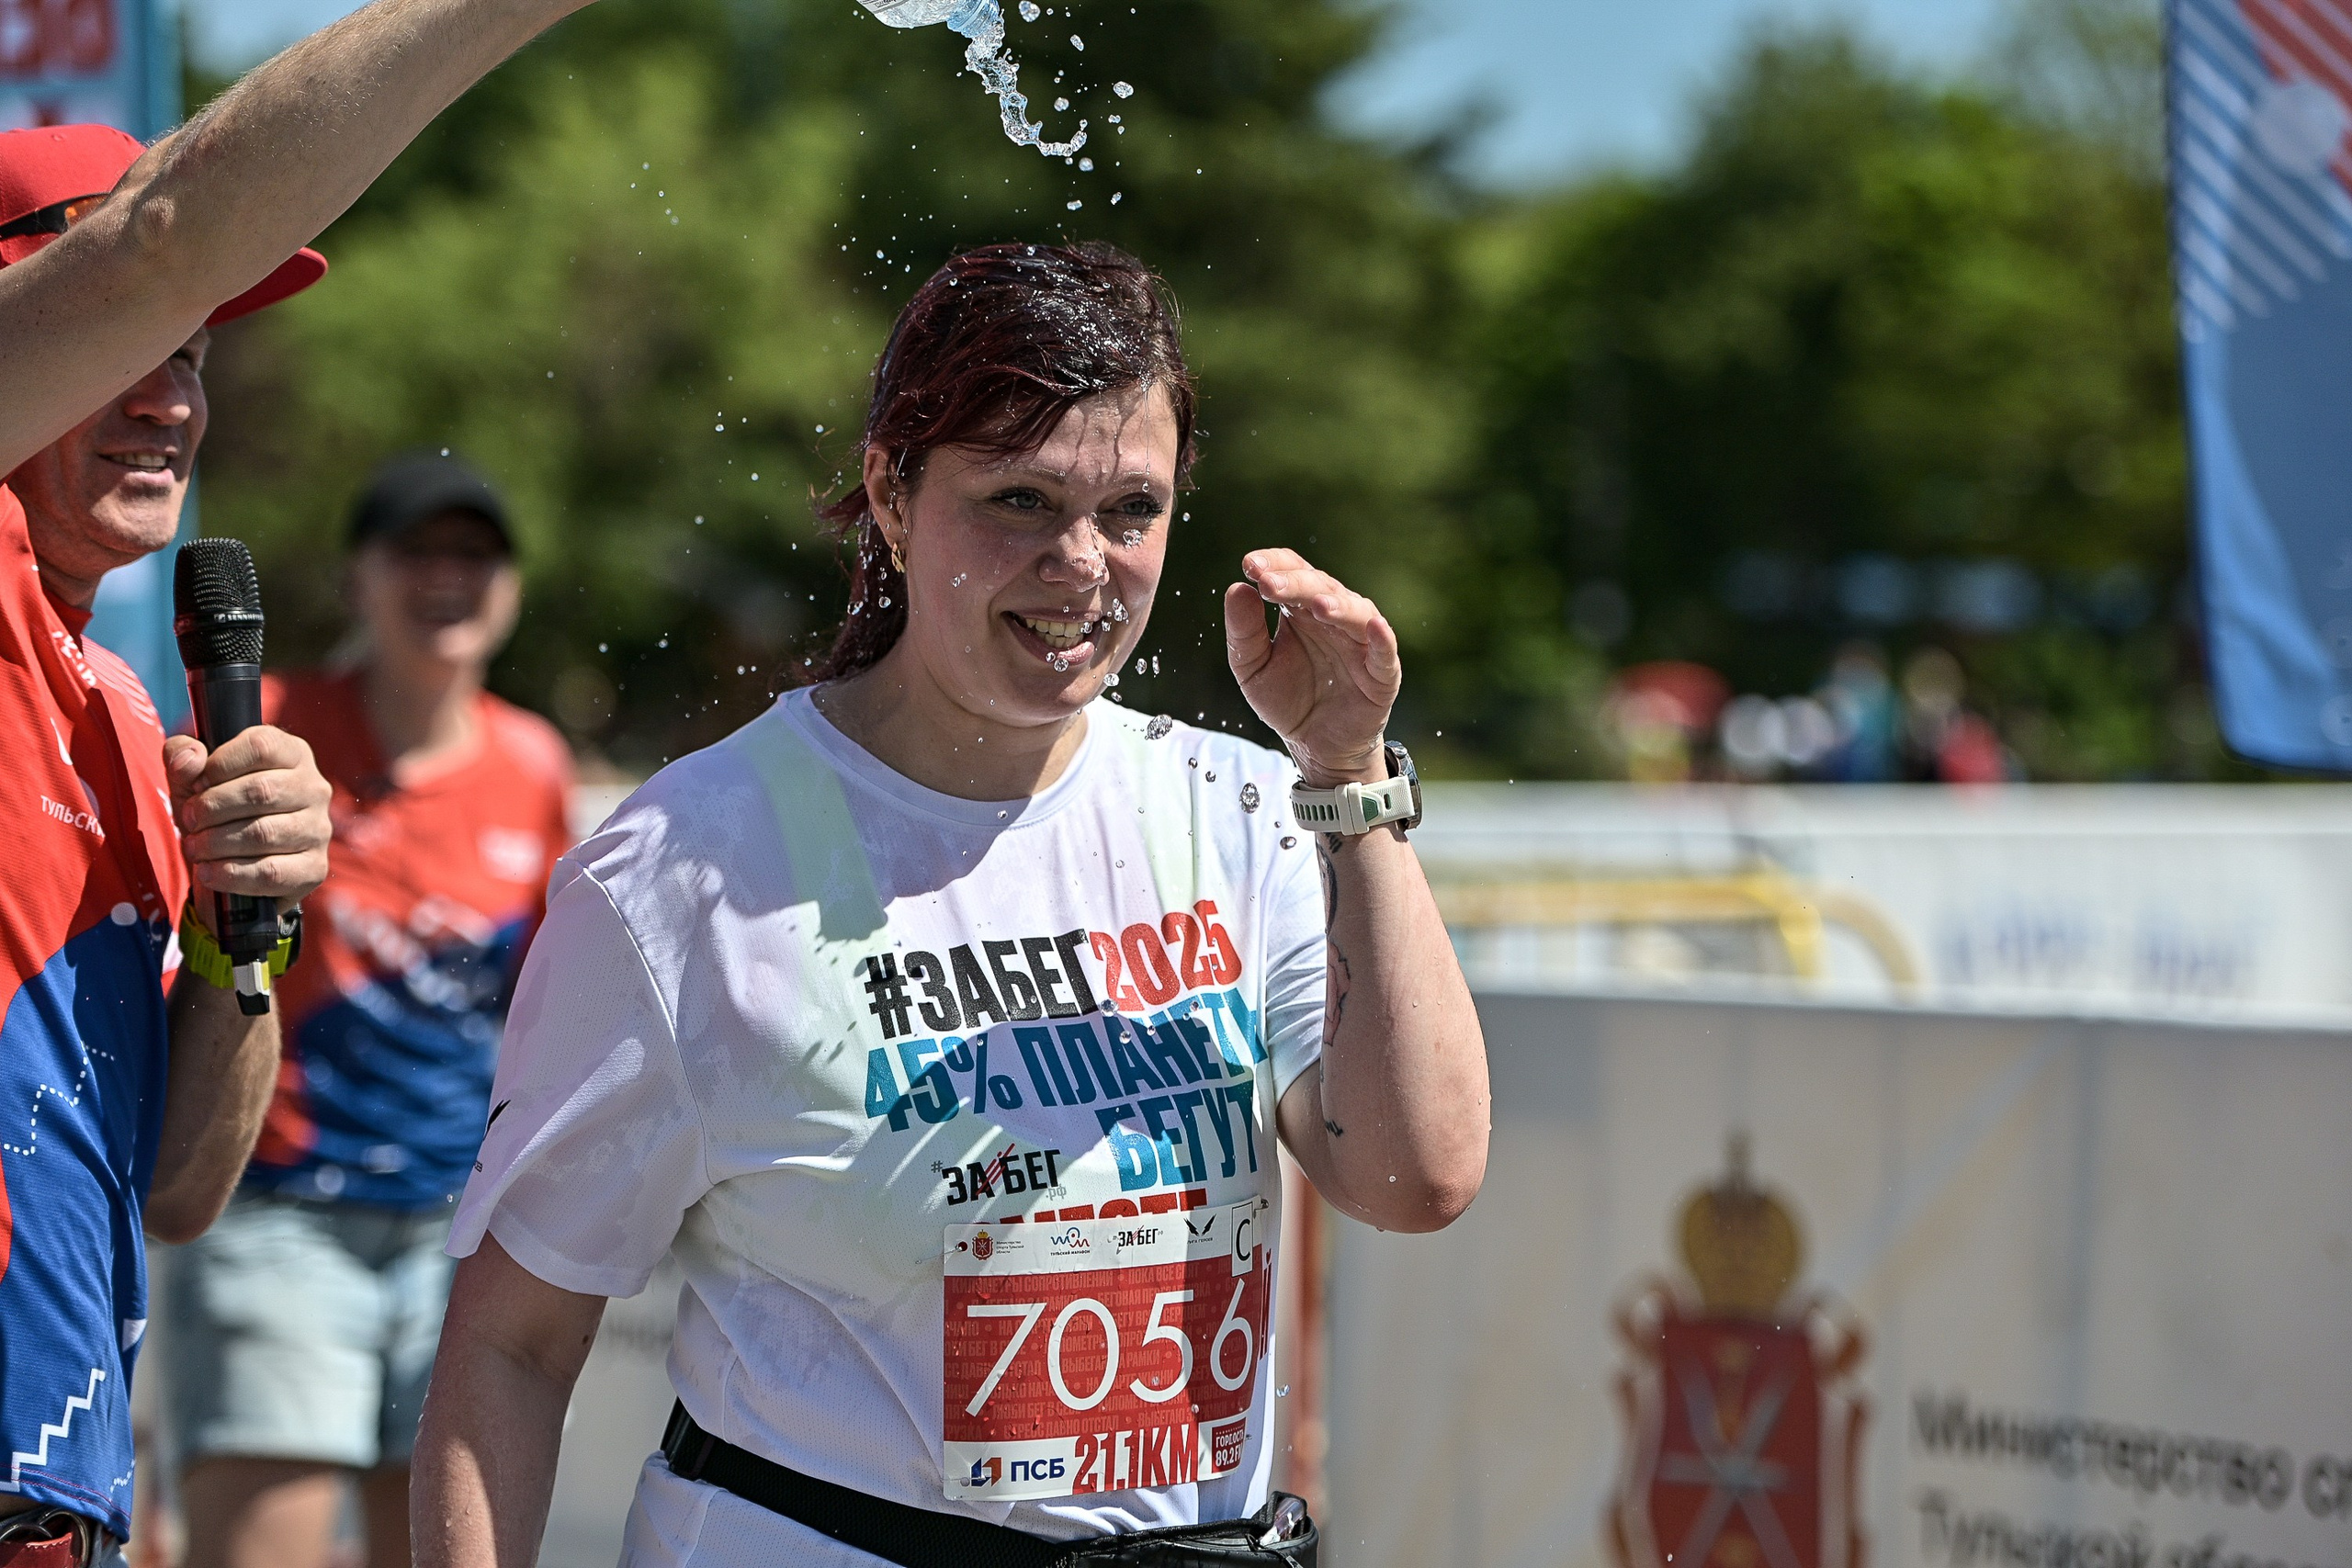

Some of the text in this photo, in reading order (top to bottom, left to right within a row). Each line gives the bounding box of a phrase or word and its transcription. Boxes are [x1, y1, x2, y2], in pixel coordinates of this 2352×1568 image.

[865, 1031, 1023, 1132] 45%
[1094, 1081, 1257, 1192] БЕГУТ
[966, 1278, 1253, 1417] 7056
[1011, 1457, 1066, 1483] ПСБ
